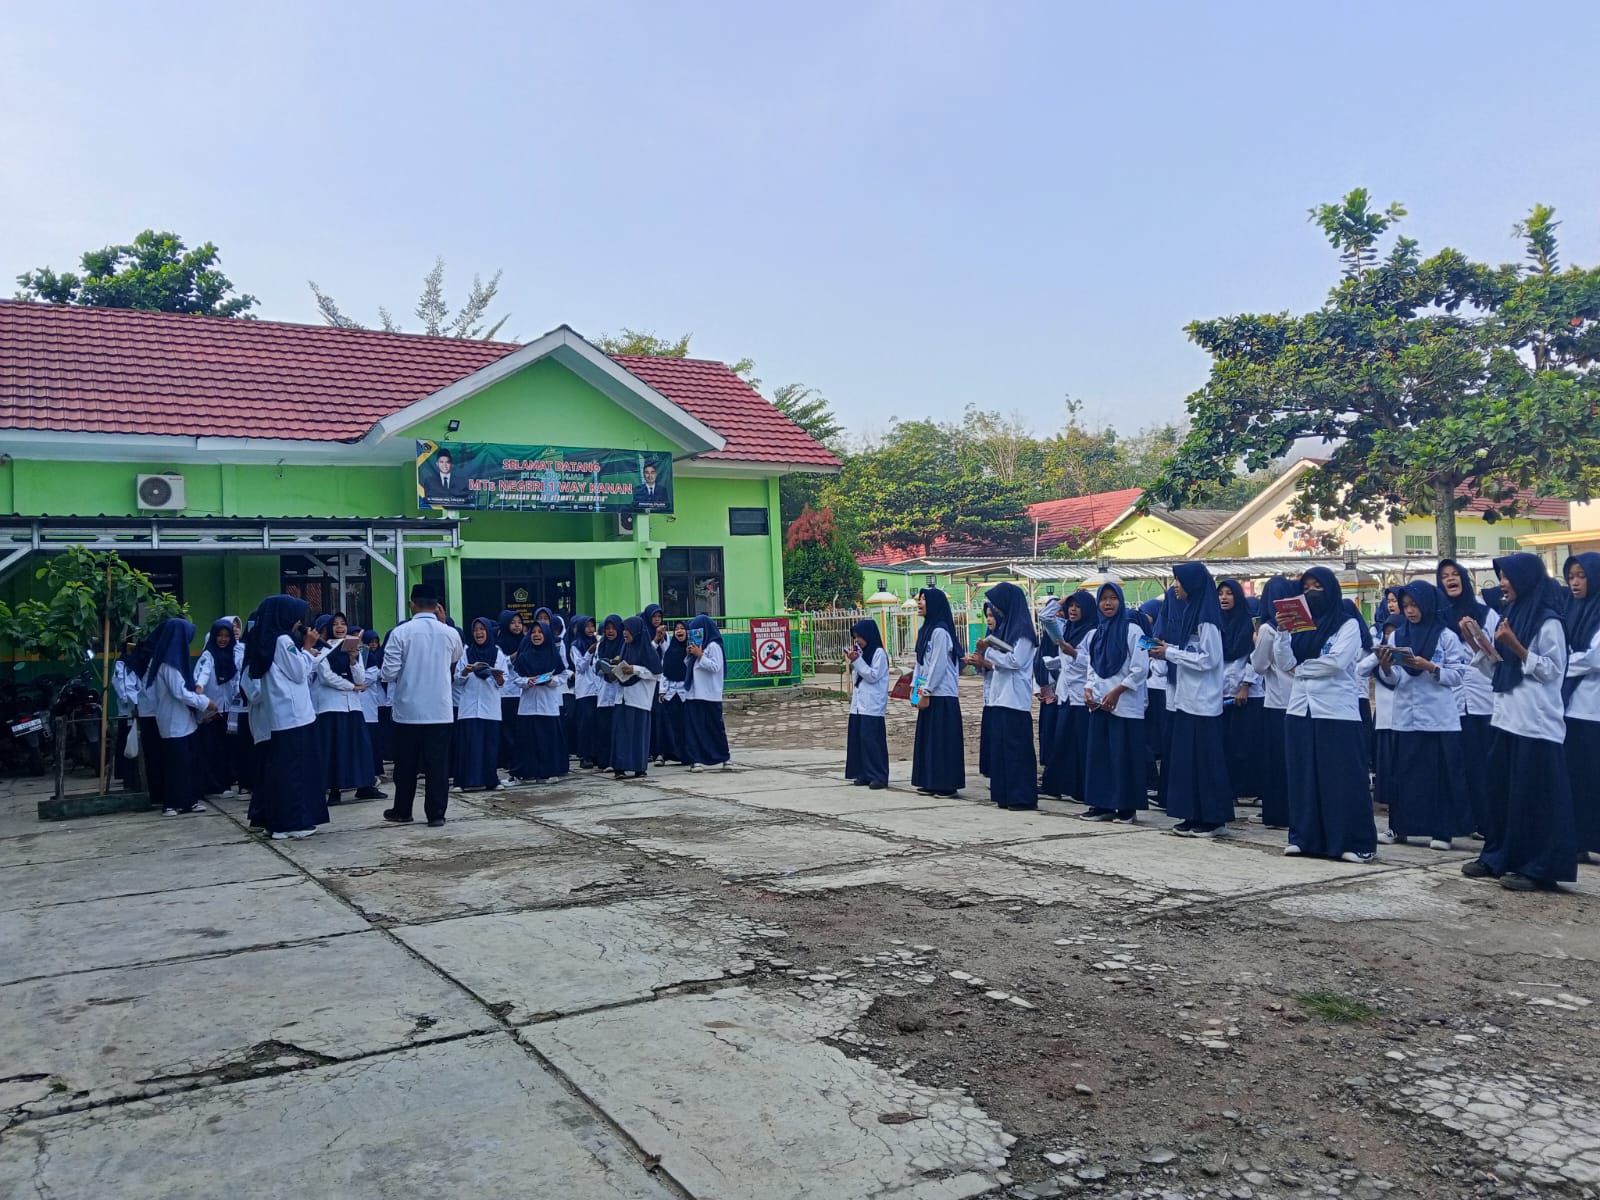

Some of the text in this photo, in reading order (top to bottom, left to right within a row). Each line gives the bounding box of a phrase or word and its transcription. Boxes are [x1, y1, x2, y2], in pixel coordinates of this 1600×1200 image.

[502, 459, 601, 473] SELAMAT DATANG
[468, 478, 633, 495] MTs NEGERI 1 WAY KANAN
